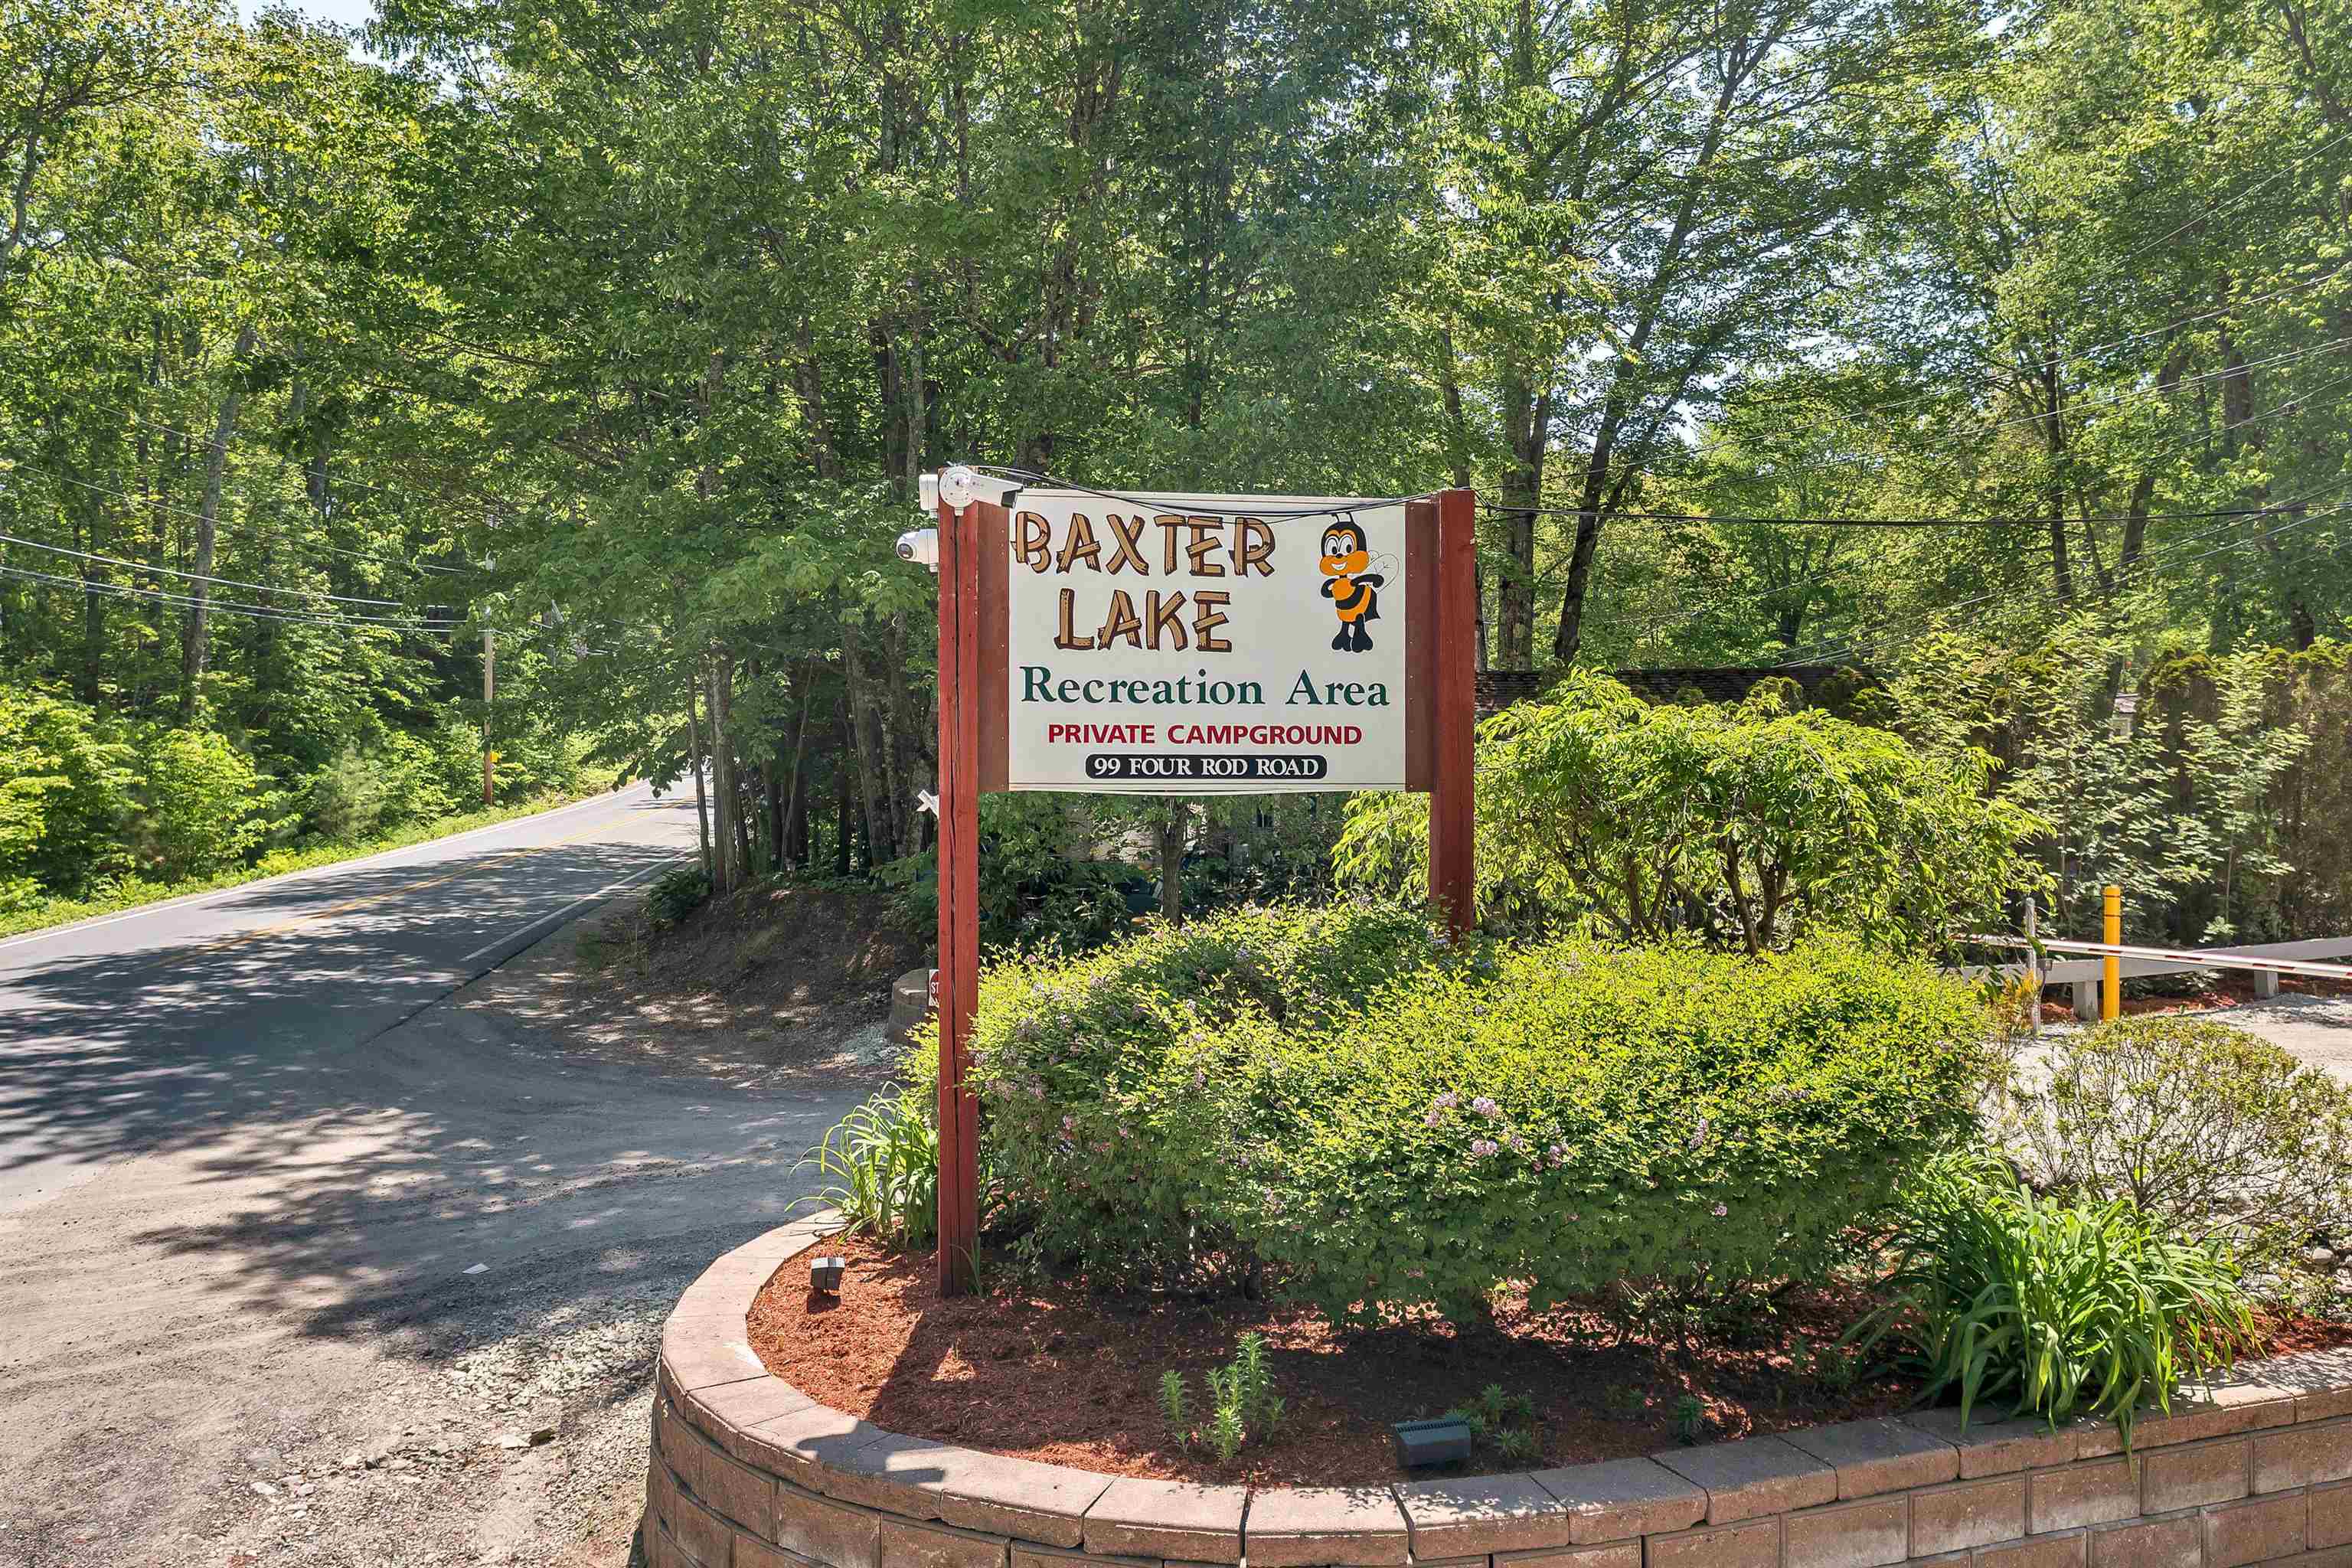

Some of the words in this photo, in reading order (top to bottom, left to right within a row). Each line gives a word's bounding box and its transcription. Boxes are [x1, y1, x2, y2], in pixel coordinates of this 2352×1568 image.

[1010, 511, 1276, 578] BAXTER
[1054, 588, 1233, 652] LAKE
[1019, 666, 1264, 705] Recreation
[1285, 668, 1391, 707] Area
[1048, 724, 1155, 744] PRIVATE
[1167, 724, 1363, 745] CAMPGROUND
[1094, 758, 1120, 776] 99
[1129, 758, 1192, 776] FOUR
[1200, 758, 1248, 776] ROD
[1255, 759, 1319, 778] ROAD
